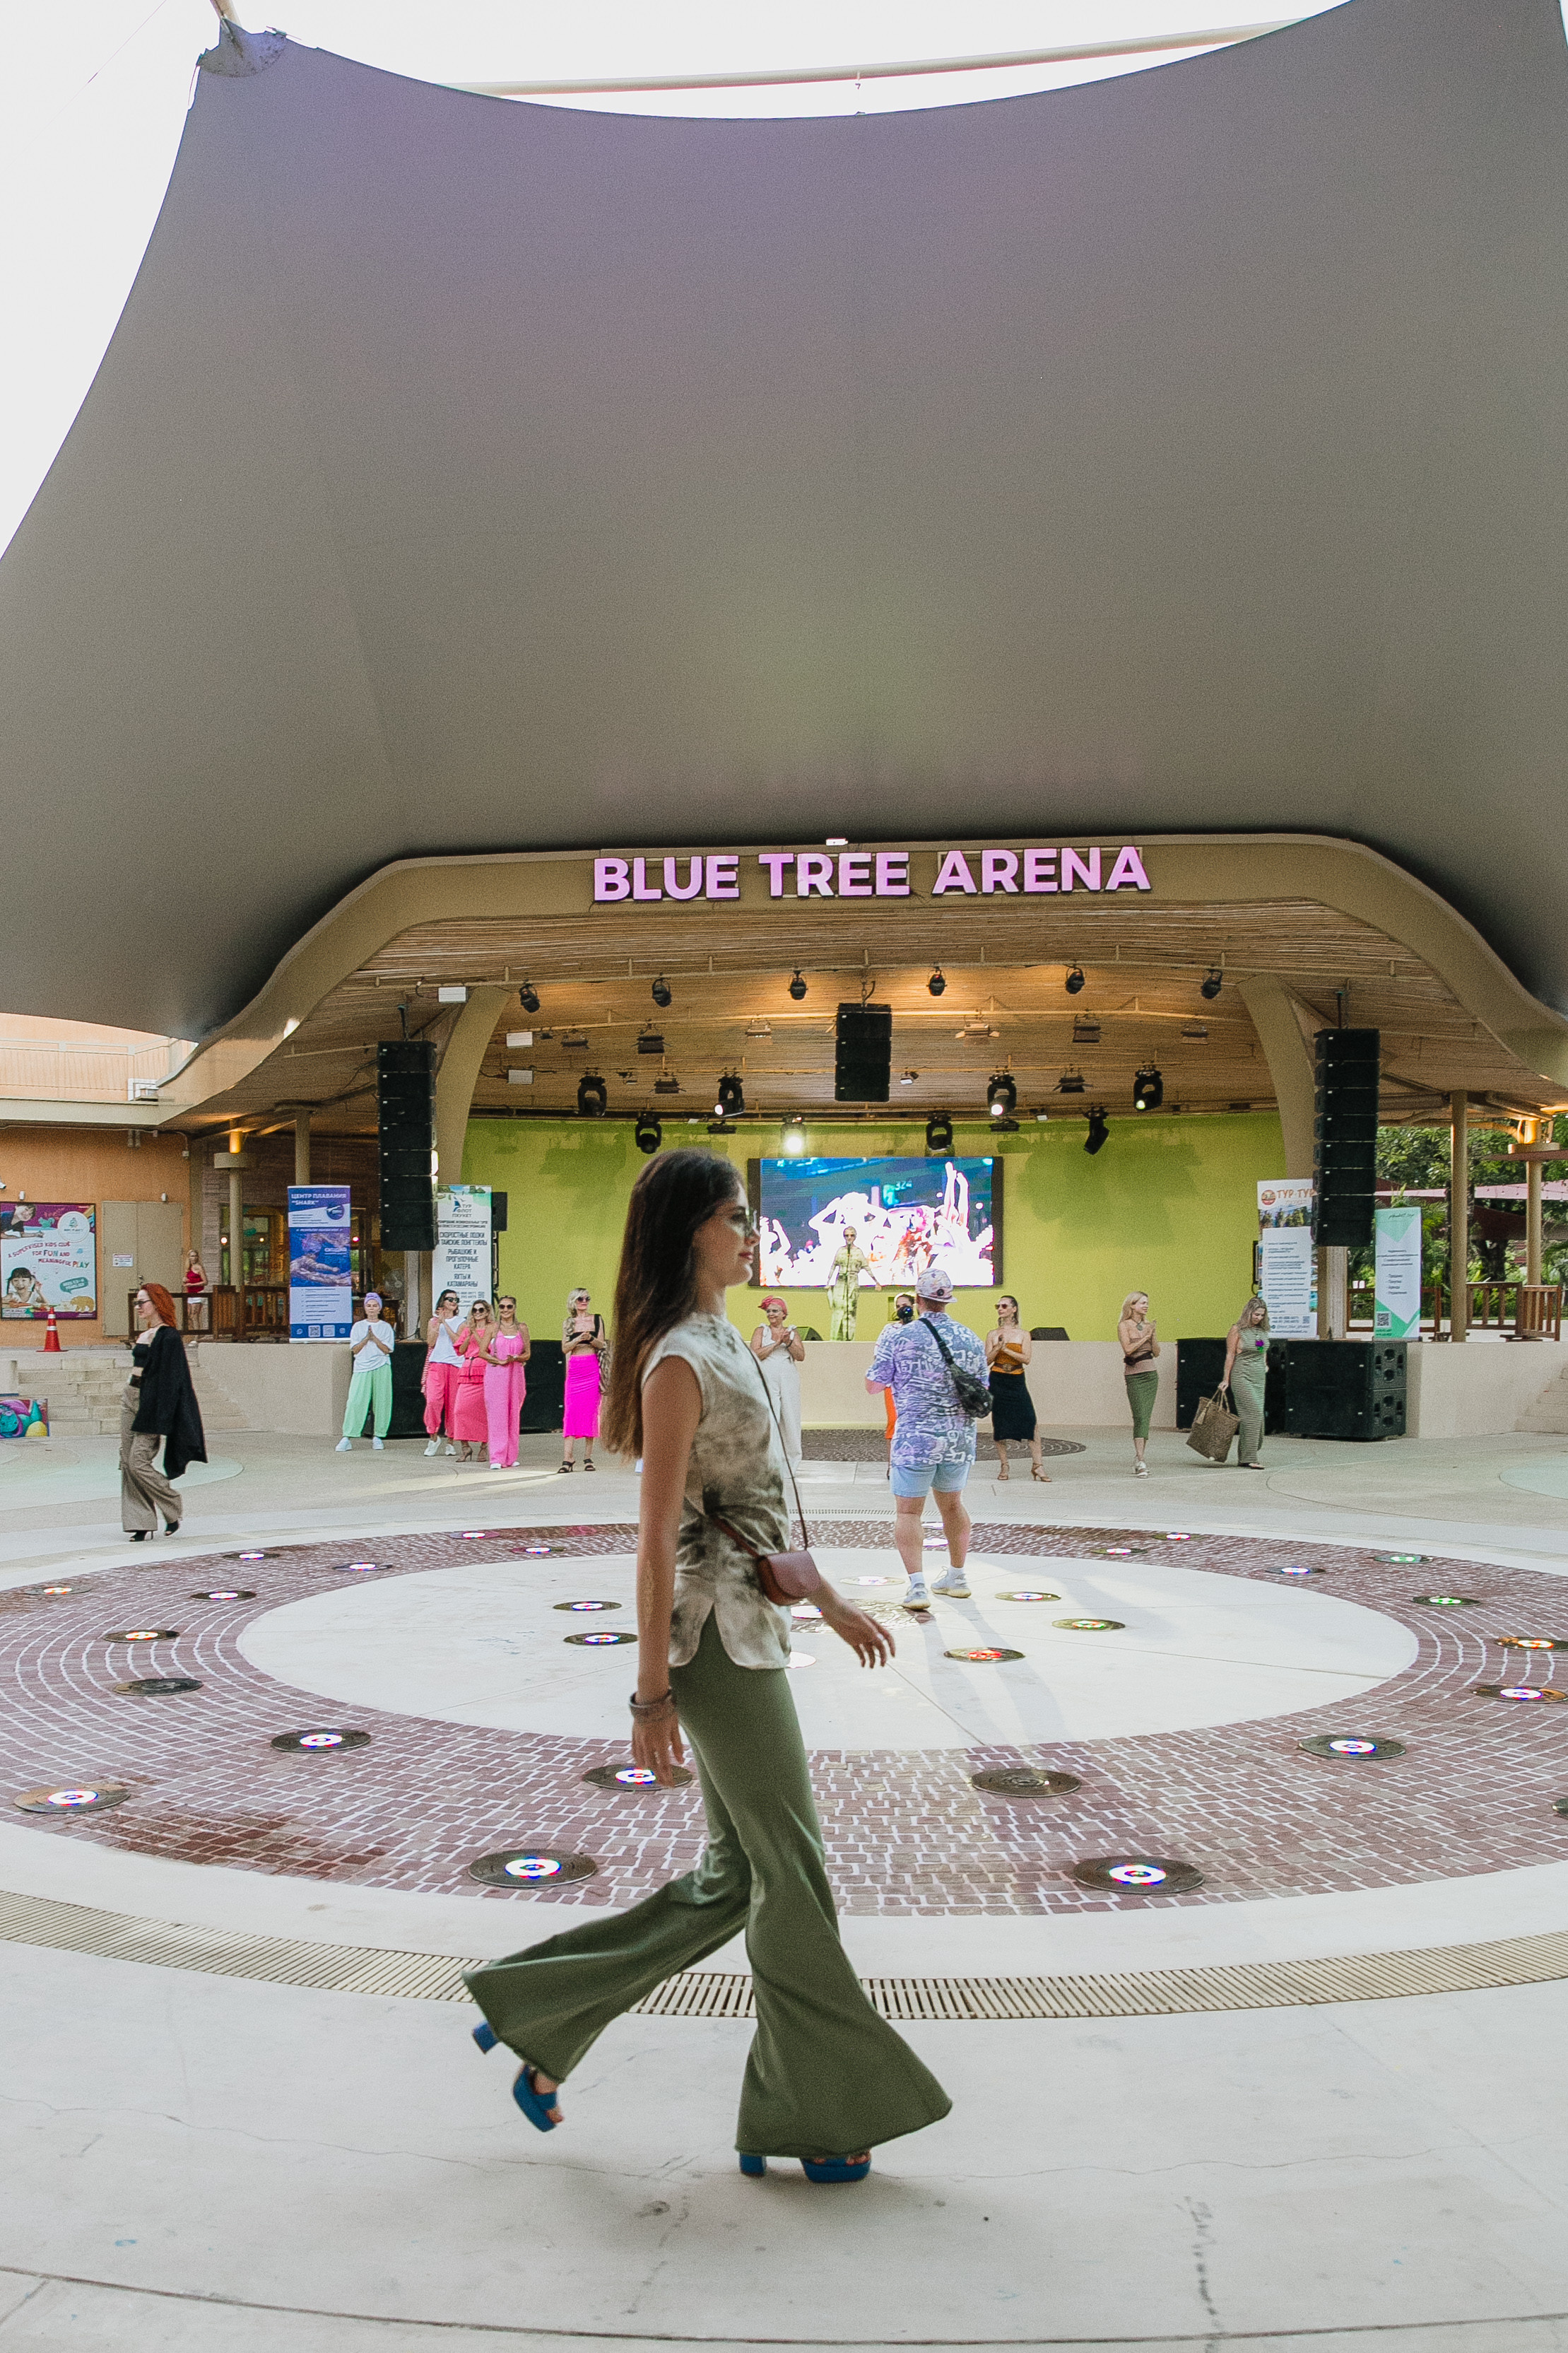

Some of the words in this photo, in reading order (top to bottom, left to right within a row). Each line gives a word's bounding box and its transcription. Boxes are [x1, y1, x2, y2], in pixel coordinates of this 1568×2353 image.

[593, 855, 740, 901] BLUE
[758, 852, 910, 898] TREE
[931, 846, 1153, 896] ARENA
[13, 1243, 43, 1257] SUPERVISED
[38, 1258, 71, 1267] MEANINGFUL
